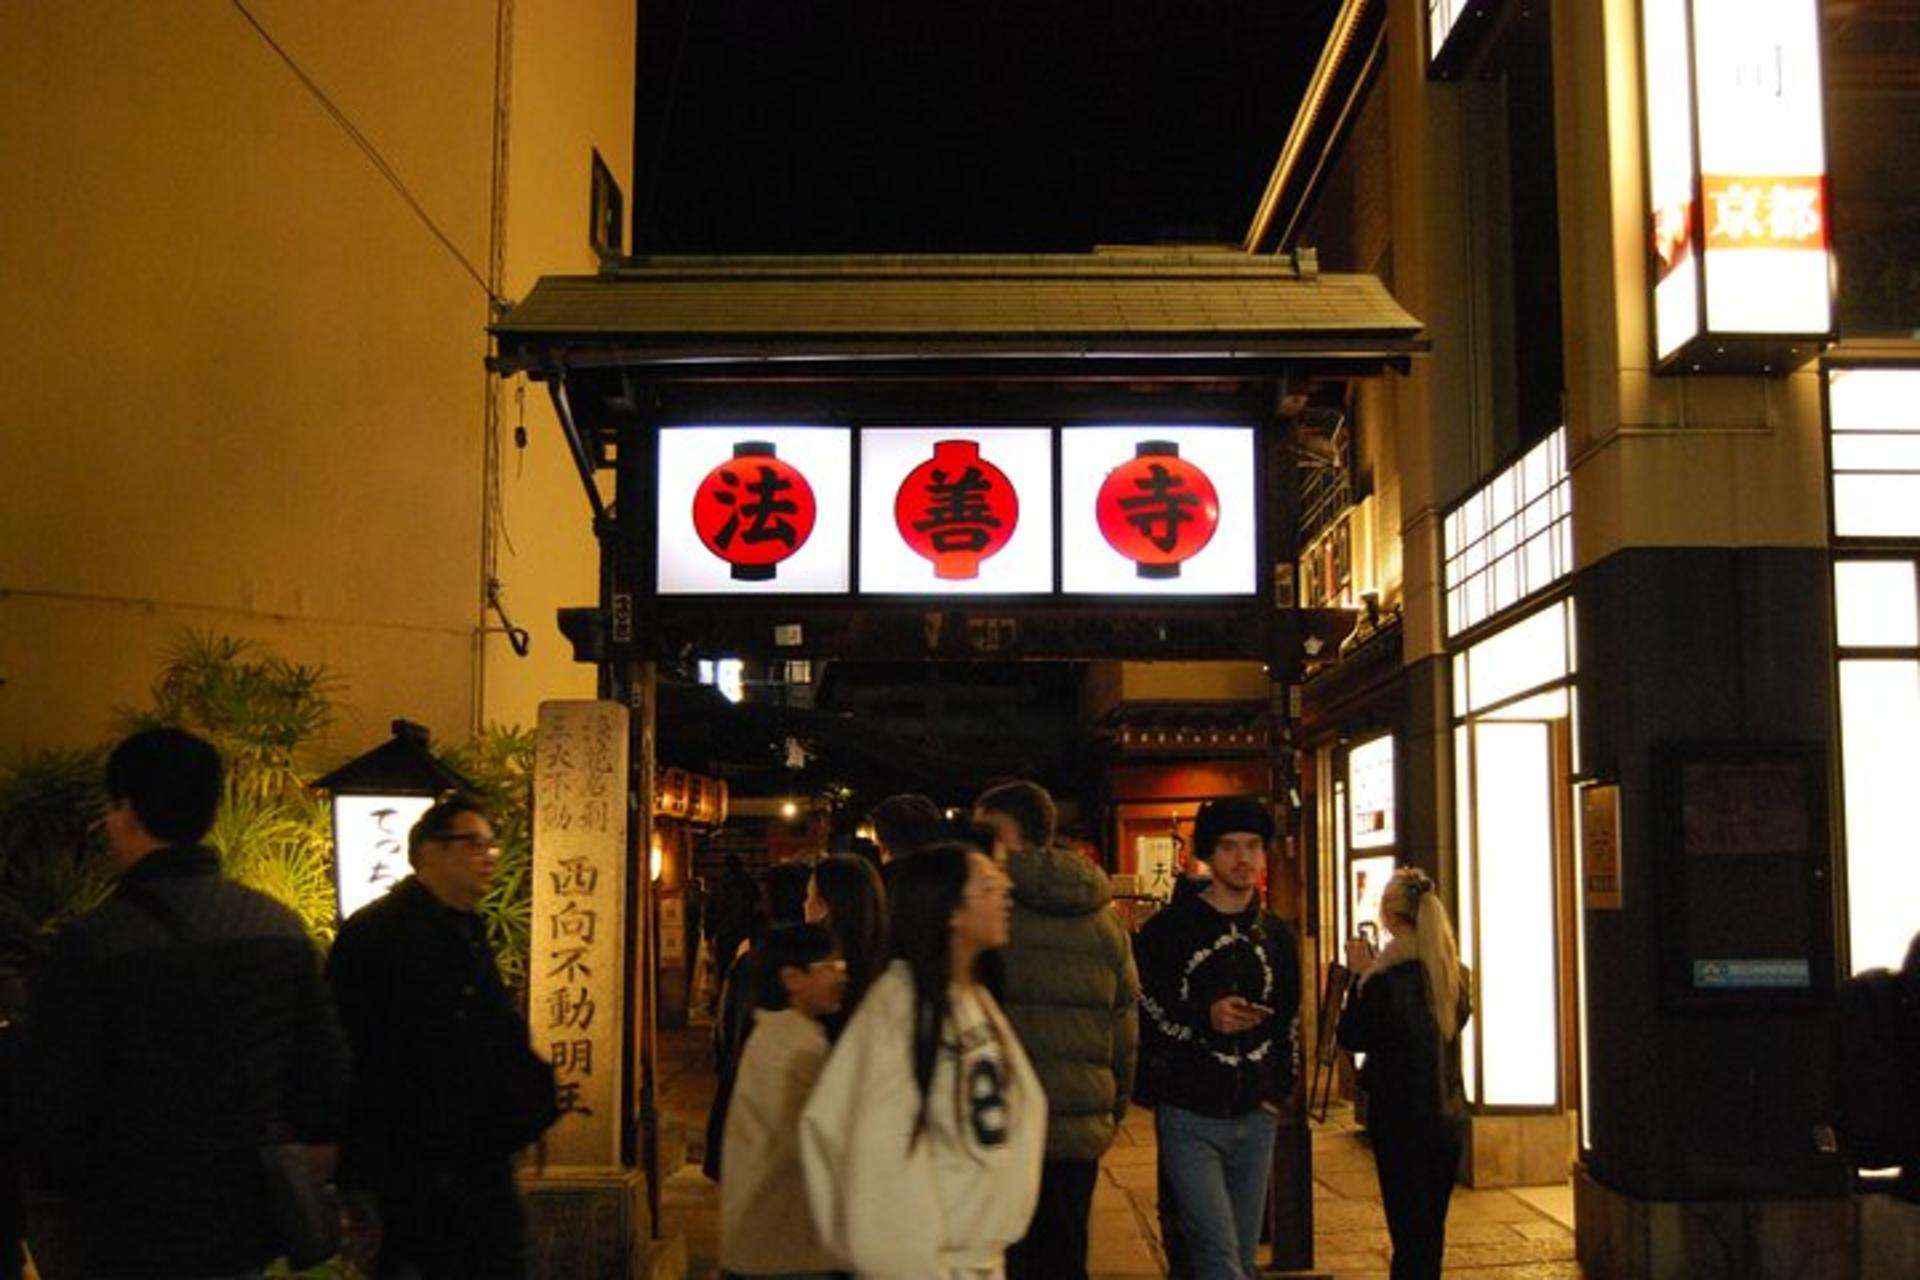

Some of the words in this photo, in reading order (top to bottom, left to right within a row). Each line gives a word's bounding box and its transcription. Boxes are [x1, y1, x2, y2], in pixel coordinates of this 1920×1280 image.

[1709, 183, 1820, 240] 京都
[711, 462, 1199, 555] 法善寺
[547, 856, 598, 1117] 西向不動明王
